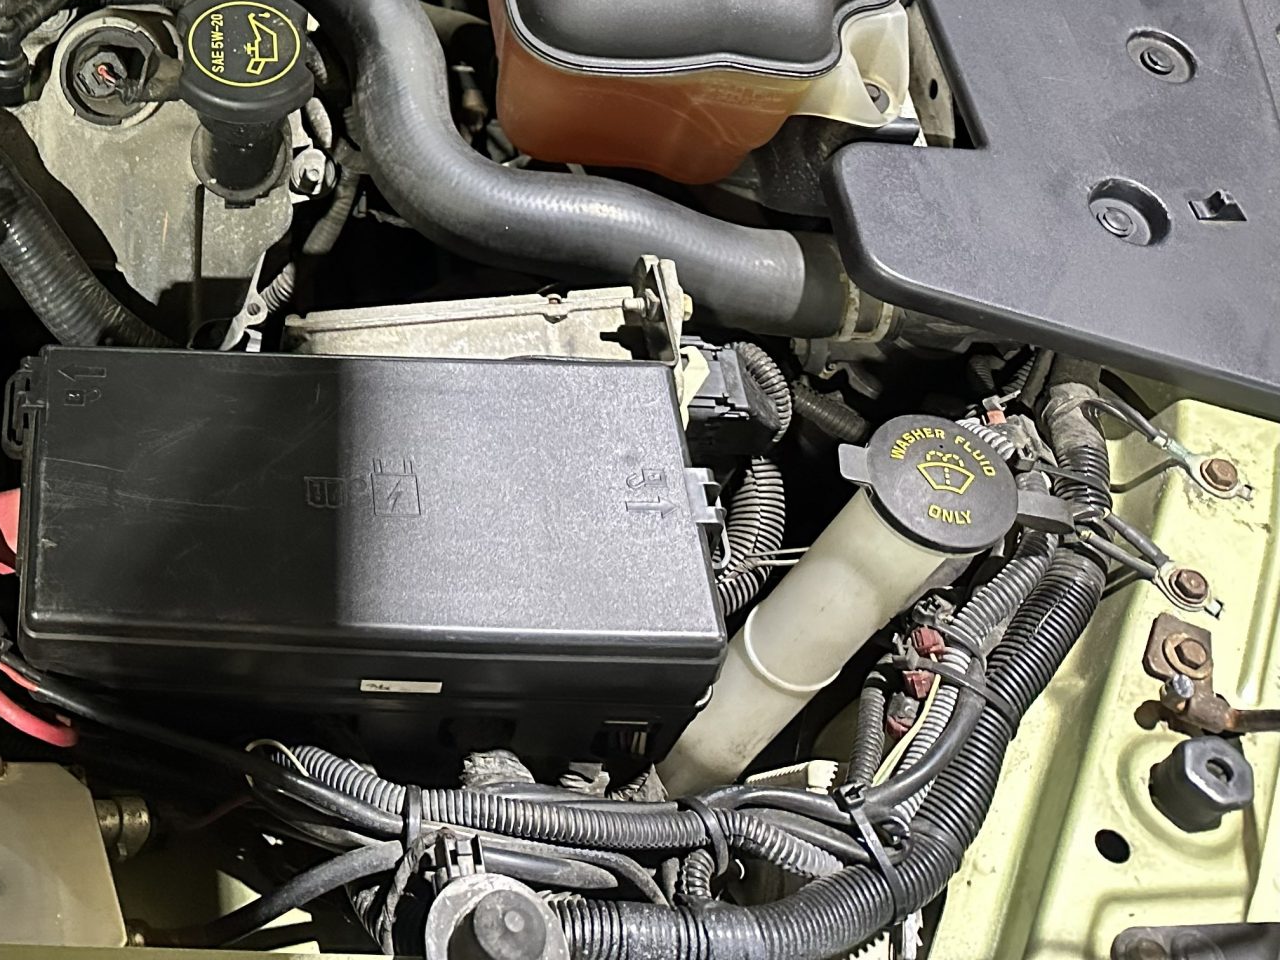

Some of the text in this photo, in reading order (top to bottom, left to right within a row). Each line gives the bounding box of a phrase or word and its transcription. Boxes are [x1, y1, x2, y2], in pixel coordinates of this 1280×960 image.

[210, 13, 224, 73] SAE 5W-20
[890, 427, 996, 477] WASHER FLUID
[928, 504, 972, 525] ONLY
